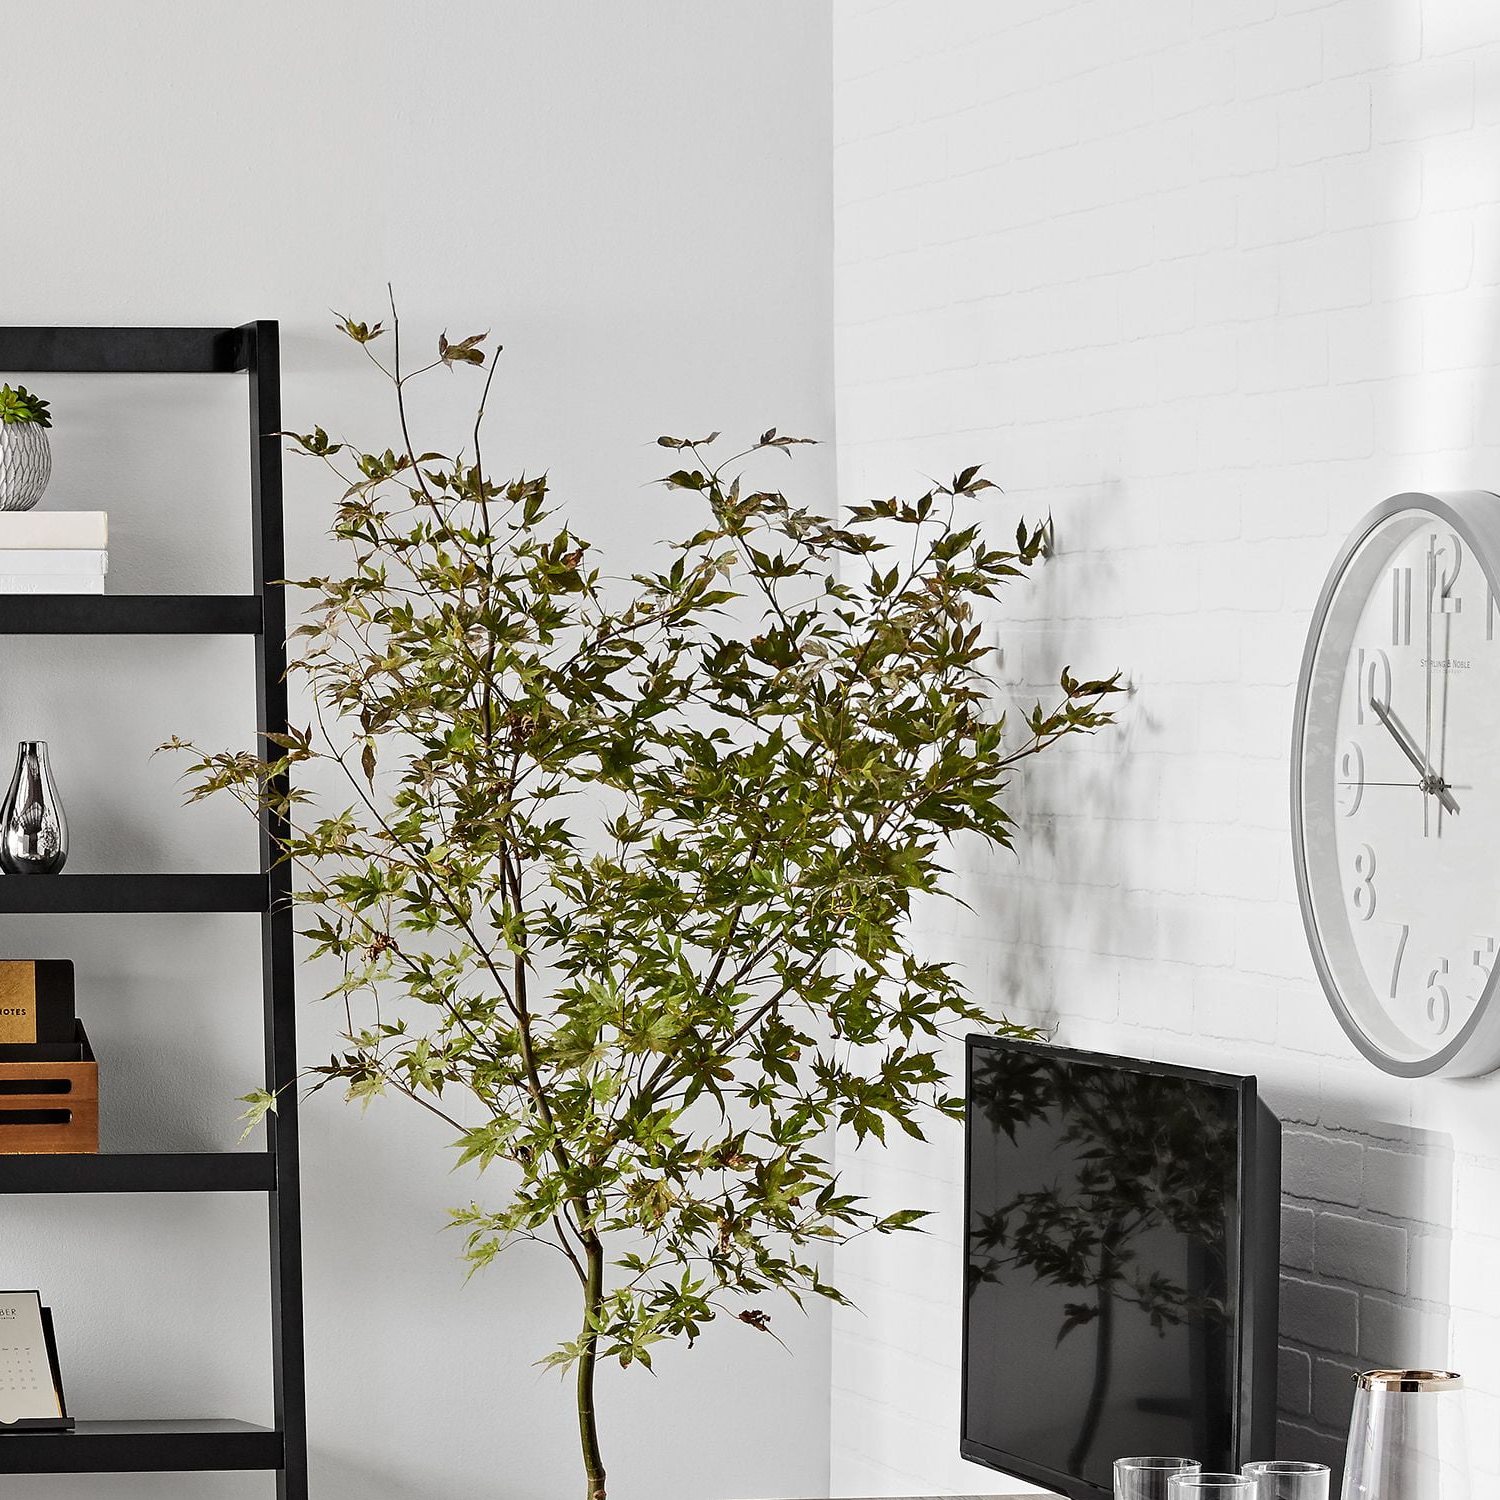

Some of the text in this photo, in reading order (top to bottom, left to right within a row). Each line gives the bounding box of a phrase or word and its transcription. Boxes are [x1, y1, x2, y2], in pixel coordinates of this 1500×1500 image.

[1388, 567, 1411, 645] 11
[1354, 648, 1392, 726] 10
[1338, 740, 1365, 817] 9
[1349, 842, 1377, 921] 8
[1382, 921, 1409, 999] 7
[1423, 956, 1450, 1036] 6
